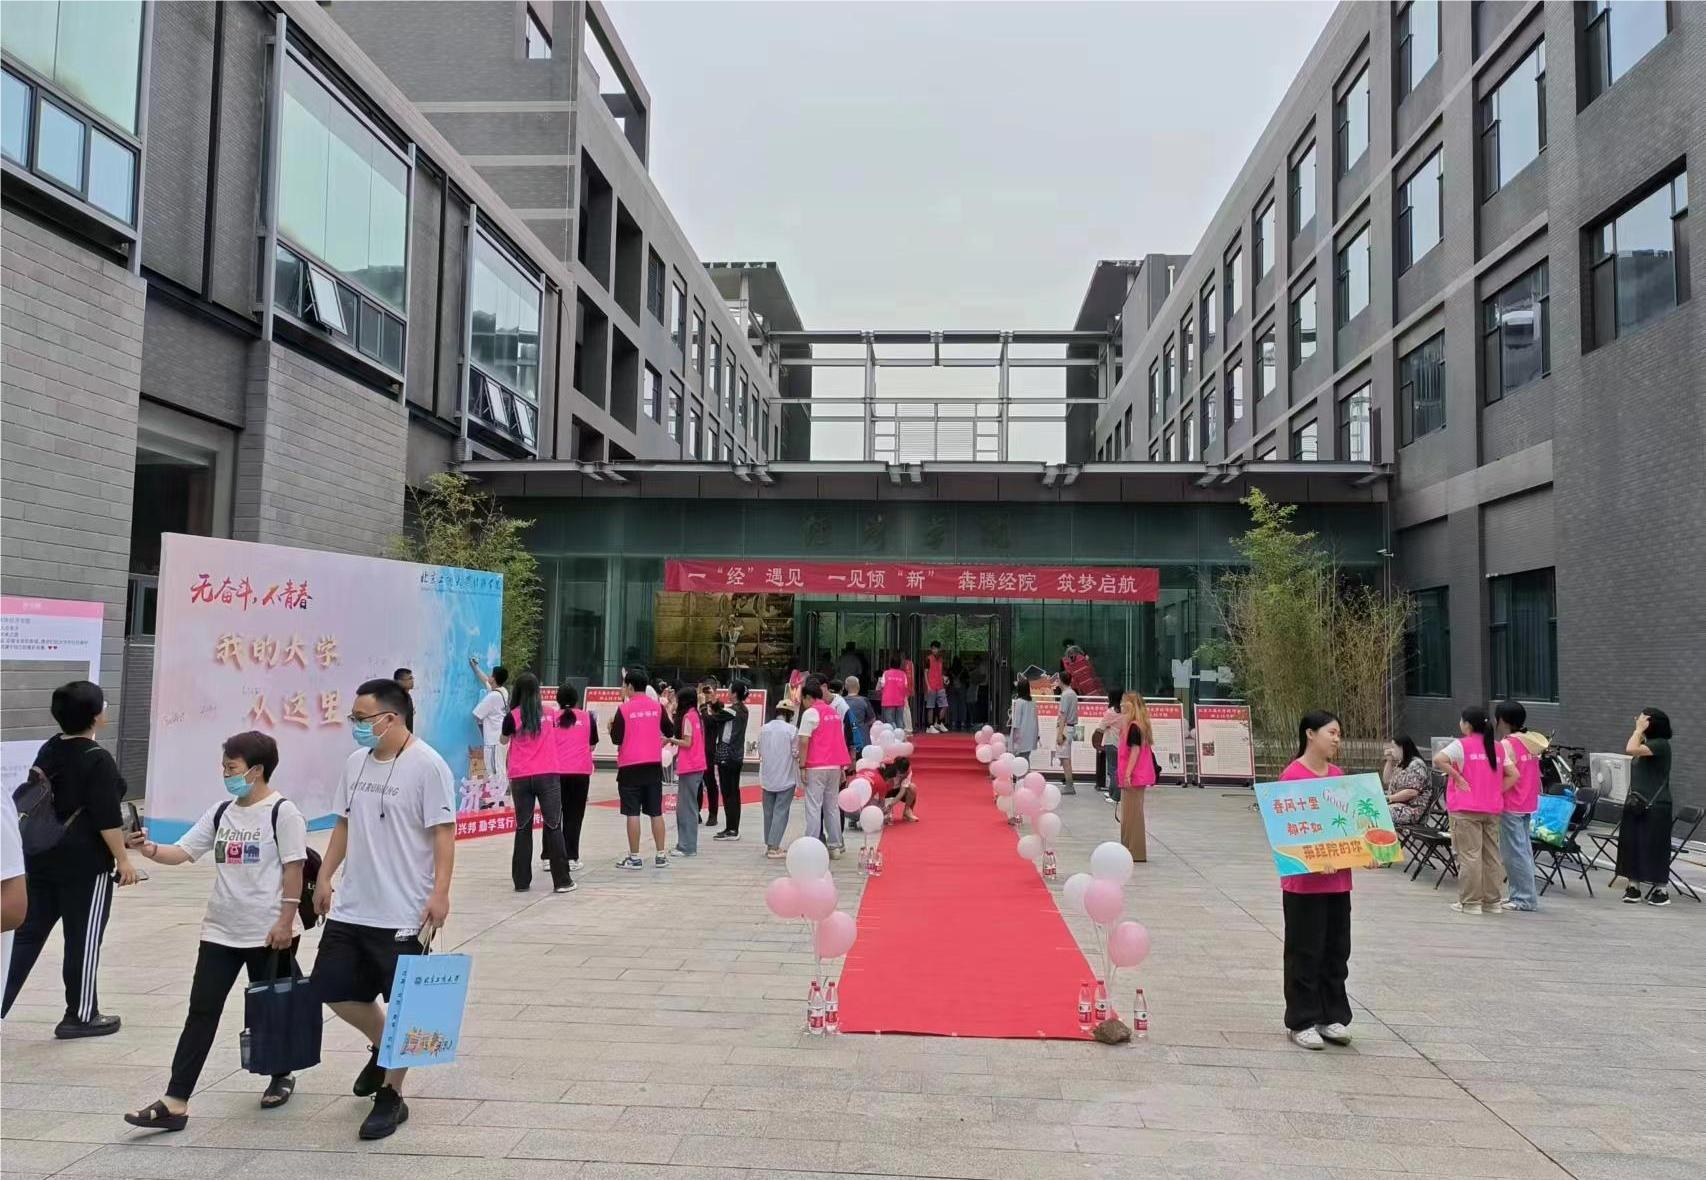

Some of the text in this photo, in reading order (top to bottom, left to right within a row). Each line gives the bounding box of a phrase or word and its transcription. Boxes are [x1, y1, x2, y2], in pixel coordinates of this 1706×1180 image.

[1057, 573, 1139, 594] 筑梦启航
[214, 631, 341, 671] 我的大学
[1273, 796, 1321, 816] 春风十里
[1287, 821, 1324, 836] 都不如
